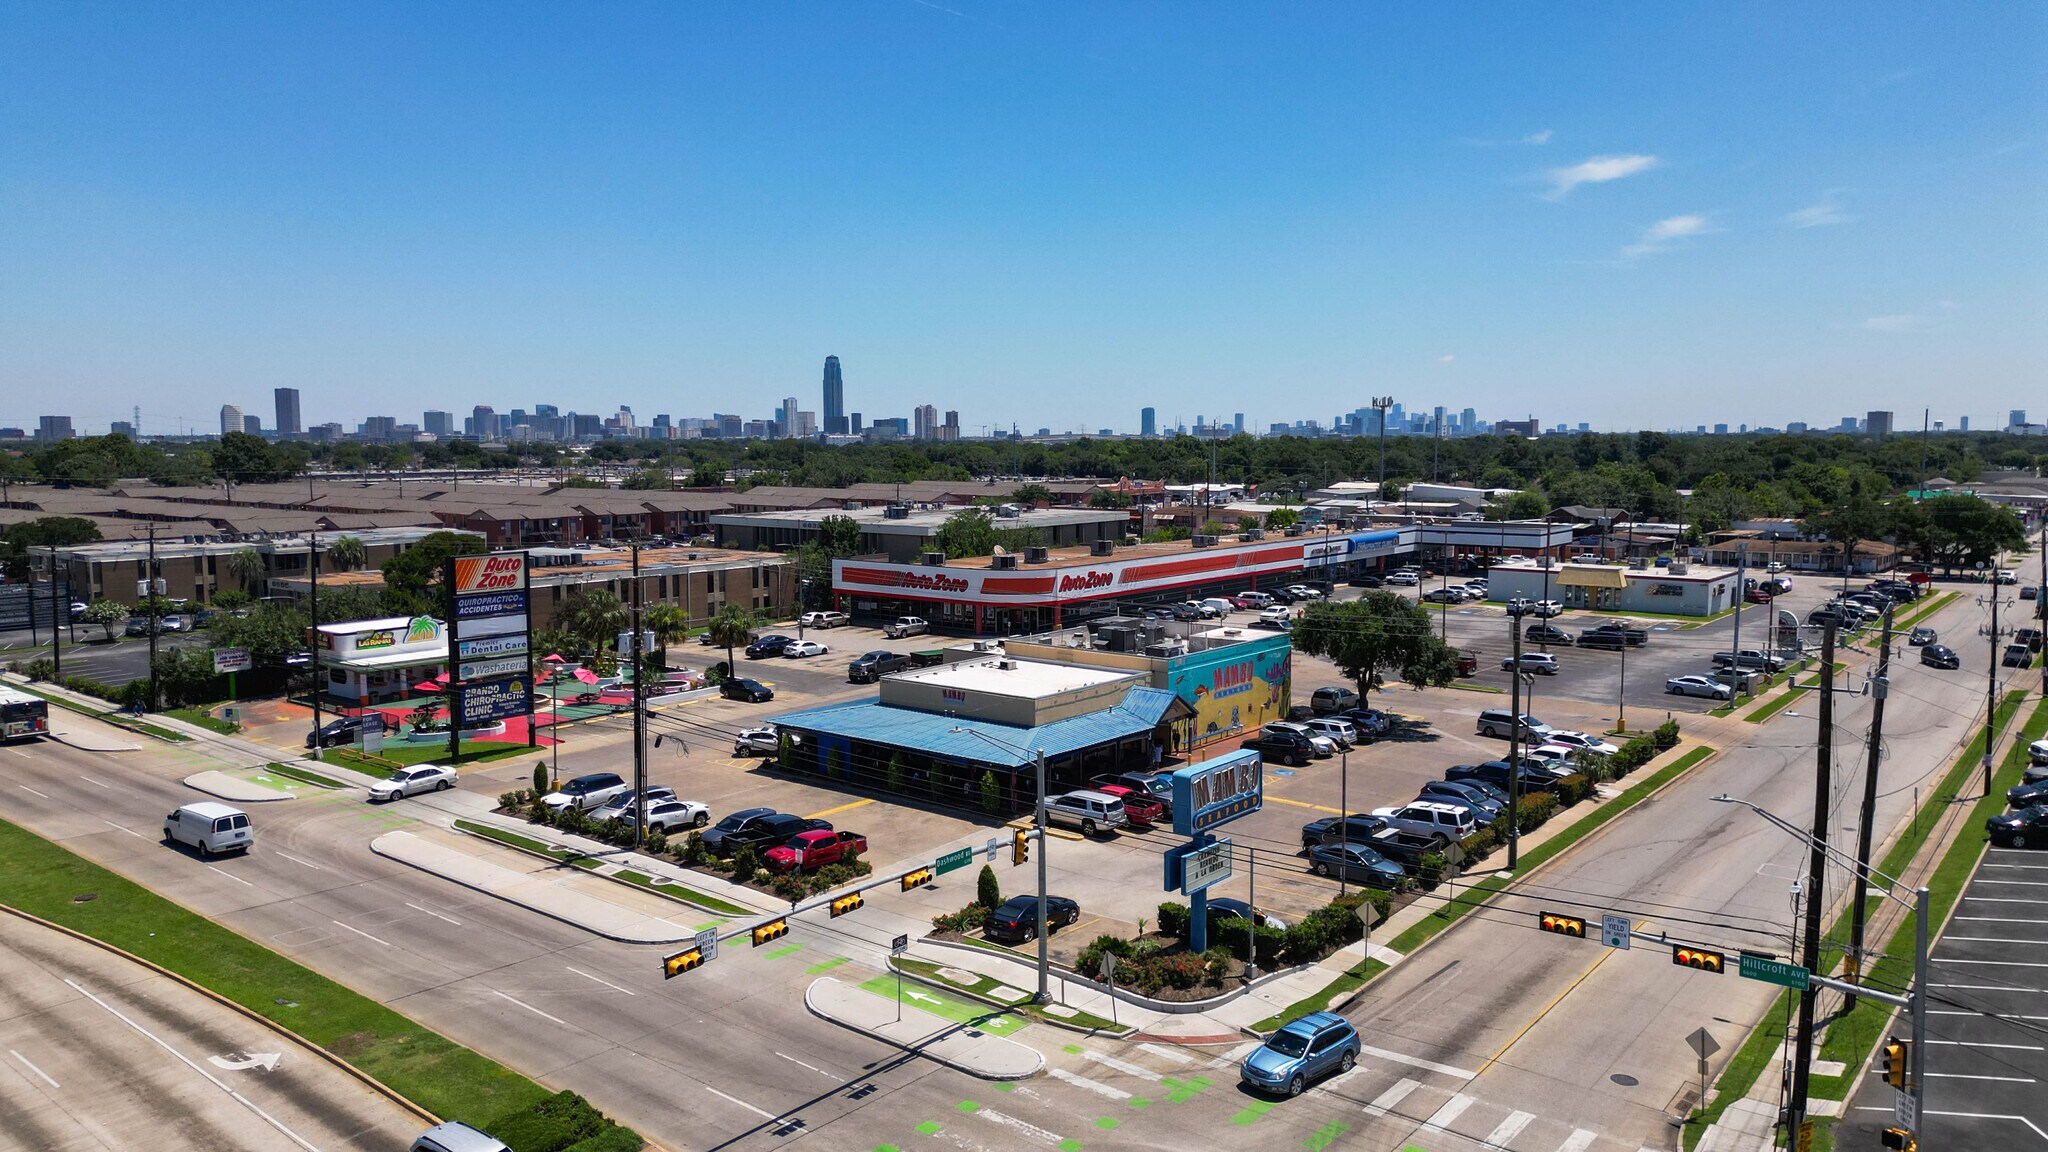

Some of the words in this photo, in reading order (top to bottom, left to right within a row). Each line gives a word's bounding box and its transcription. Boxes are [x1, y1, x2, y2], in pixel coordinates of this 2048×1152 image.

[484, 556, 522, 573] Auto
[475, 573, 517, 589] Zone
[901, 571, 968, 592] AutoZone
[1059, 571, 1113, 592] AutoZone
[458, 594, 519, 607] QUIROPRACTICO
[459, 603, 503, 615] ACCIDENTES
[471, 644, 502, 654] Dental
[505, 642, 527, 650] Care
[476, 661, 527, 674] Washateria
[1213, 660, 1254, 691] MAMBO
[464, 690, 525, 707] CHIROPRACTIC
[465, 685, 500, 698] BRANDO
[464, 705, 493, 717] CLINIC
[1192, 760, 1260, 811] MAMBO
[1199, 797, 1257, 826] SEAFOOD
[936, 851, 964, 867] Dashwood
[1201, 868, 1207, 877] LA
[1608, 923, 1625, 933] YIELD
[697, 933, 708, 942] LEFT
[1742, 969, 1757, 977] 6600
[1743, 958, 1787, 975] Hillcroft
[1791, 970, 1806, 980] AVE
